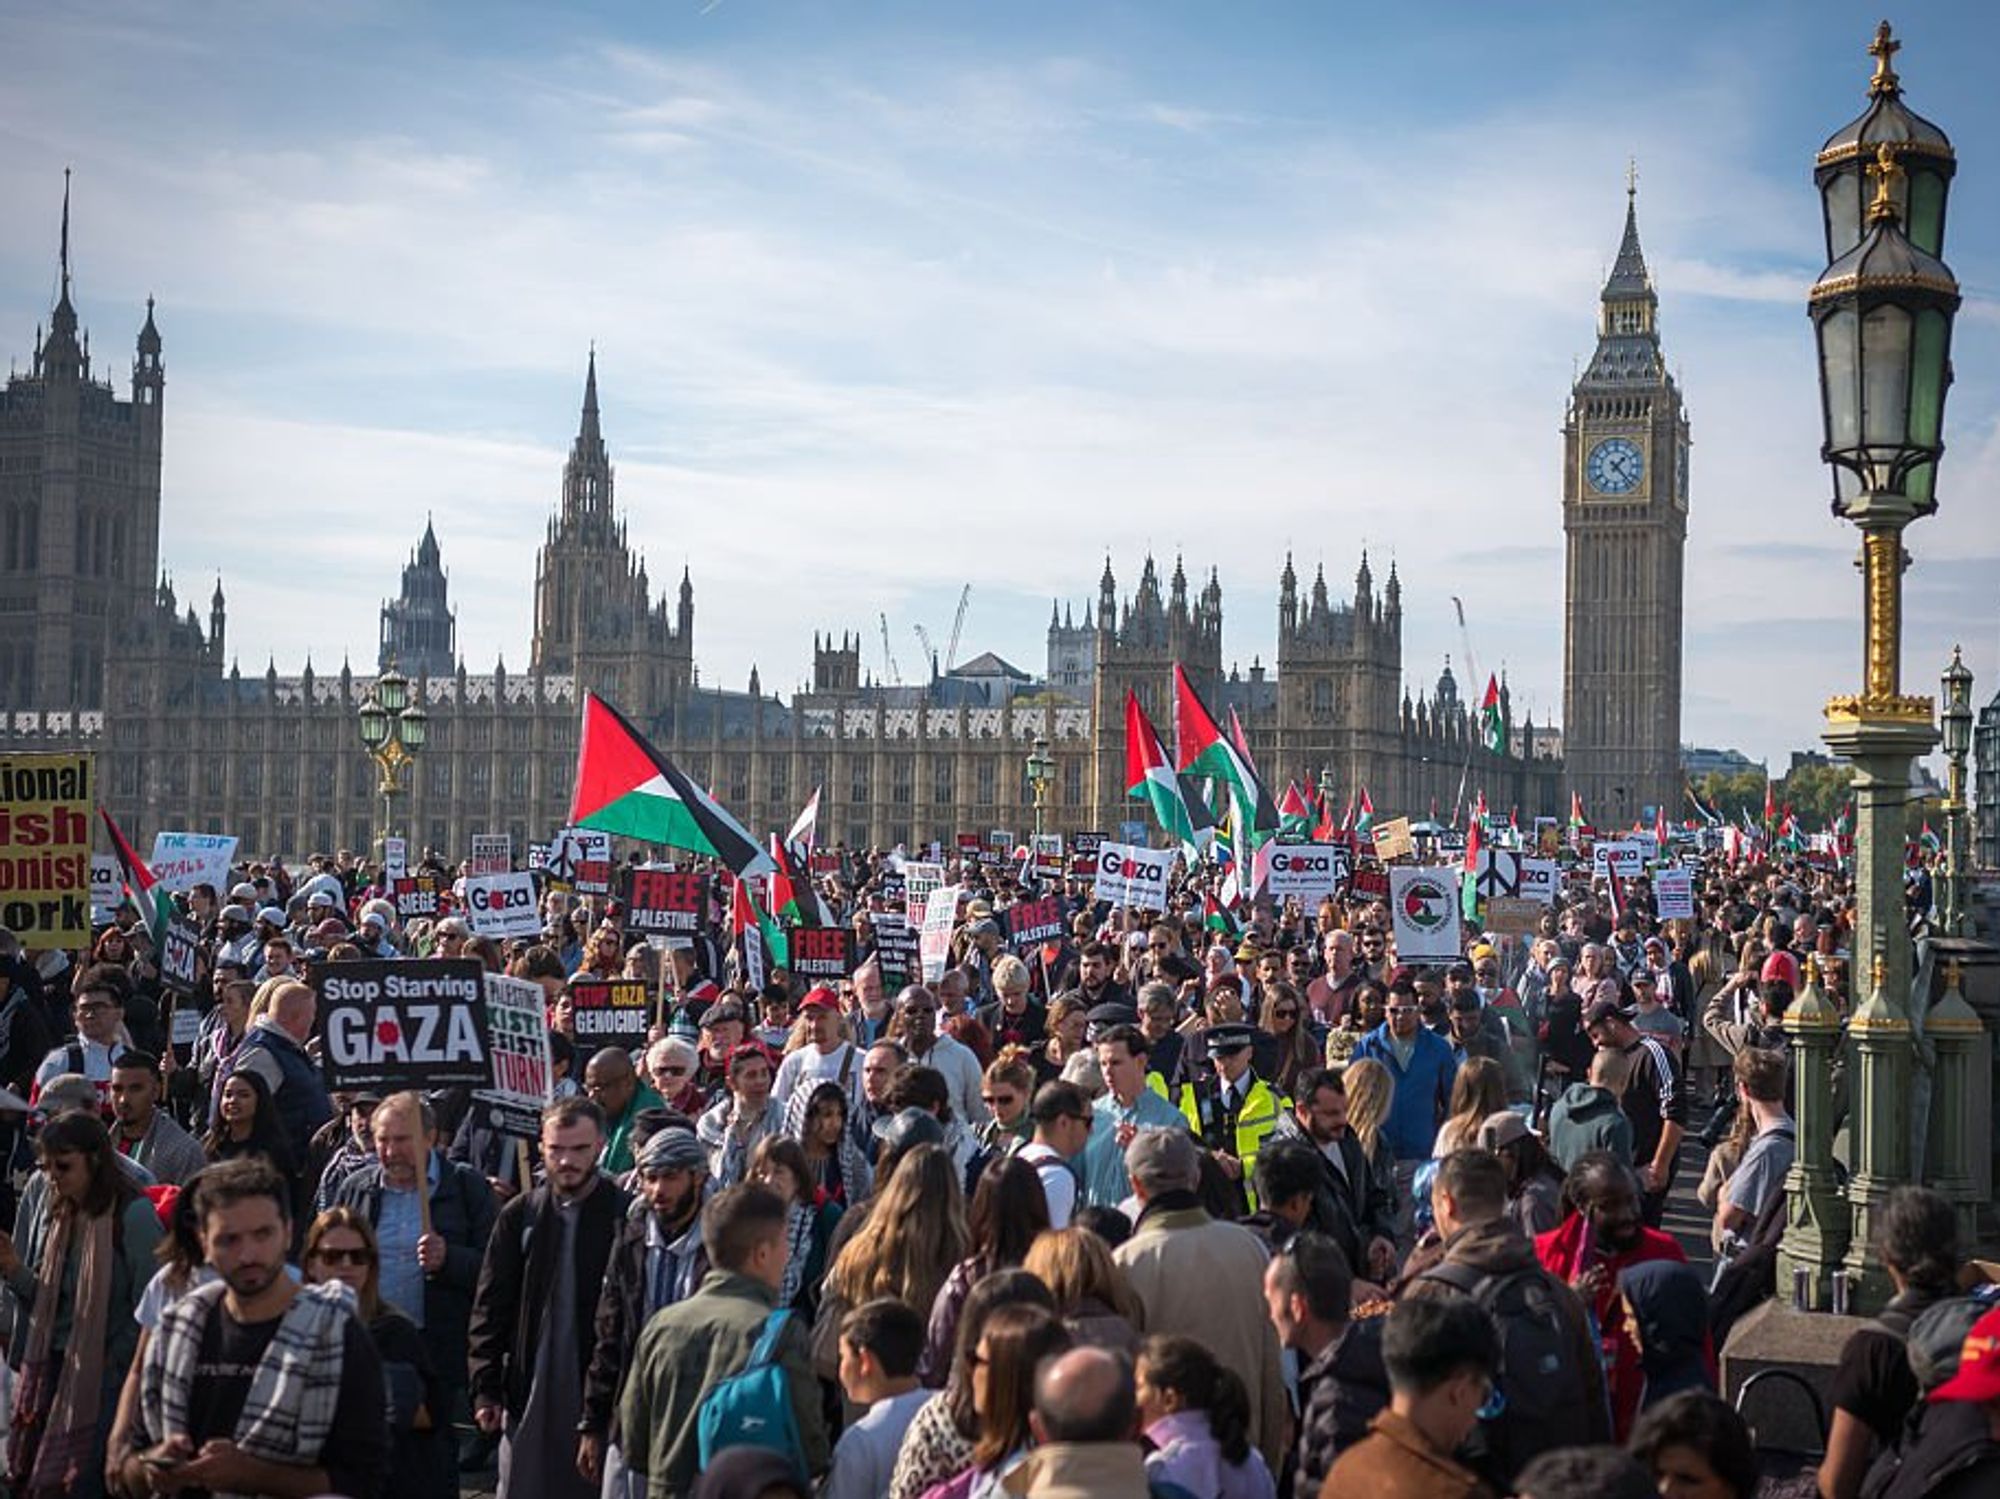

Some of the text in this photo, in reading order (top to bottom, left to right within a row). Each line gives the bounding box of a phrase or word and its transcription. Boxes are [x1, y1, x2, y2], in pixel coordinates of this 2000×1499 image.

[0, 760, 87, 801] ional
[0, 806, 87, 846] ish
[0, 852, 86, 890] onist
[90, 867, 111, 884] za
[398, 892, 437, 915] SIEGE
[632, 871, 701, 912] FREE
[3, 895, 85, 931] ork
[630, 909, 698, 930] PALESTINE
[1010, 896, 1059, 932] FREE
[794, 928, 845, 960] FREE
[323, 974, 478, 1003] Stop Starving
[574, 984, 645, 1005] STOP GAZA
[327, 1004, 485, 1066] GAZA
[487, 1007, 542, 1037] XIST!
[575, 1009, 648, 1034] GENOCIDE
[492, 1049, 547, 1099] TURN!
